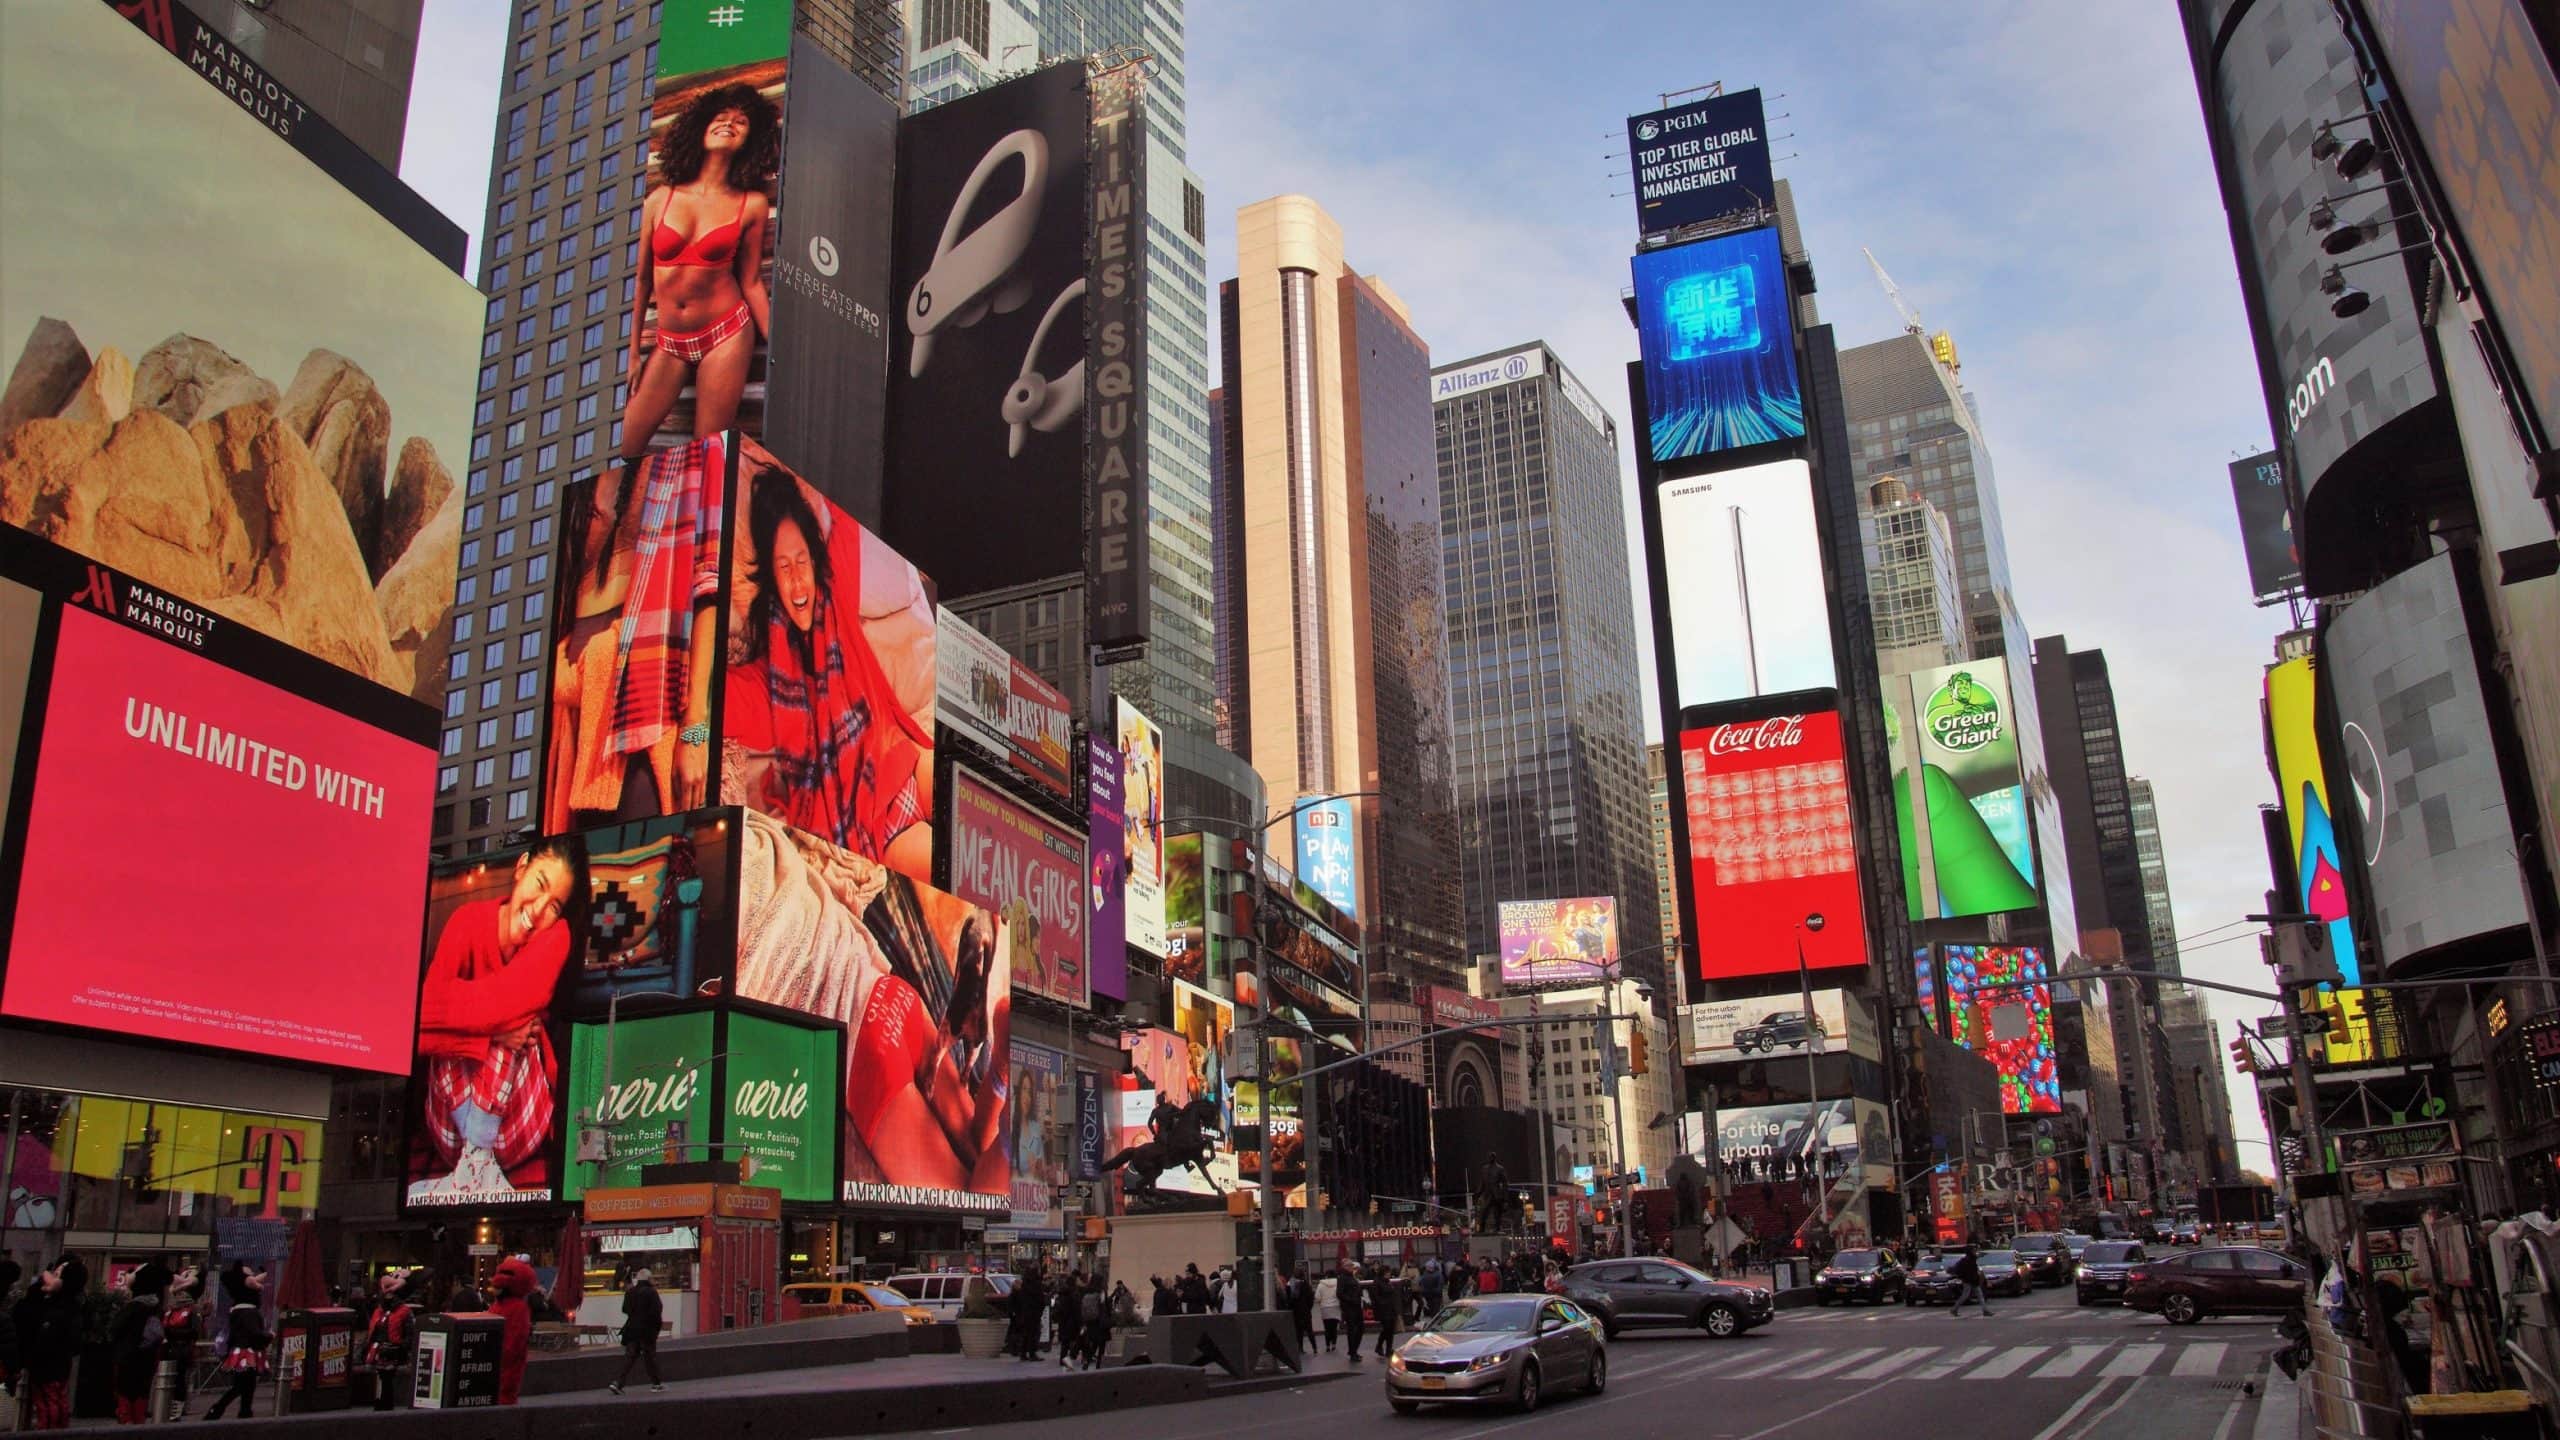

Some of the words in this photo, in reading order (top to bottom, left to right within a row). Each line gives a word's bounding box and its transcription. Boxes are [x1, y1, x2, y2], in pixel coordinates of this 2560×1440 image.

[195, 25, 306, 122] MARRIOTT
[191, 49, 291, 137] MARQUIS
[1664, 110, 1708, 133] PGIM
[1638, 147, 1666, 166] TOP
[1669, 140, 1700, 159] TIER
[1704, 127, 1758, 152] GLOBAL
[1642, 151, 1726, 182] INVESTMENT
[1643, 166, 1737, 201] MANAGEMENT
[1095, 110, 1131, 299] TIMES
[1438, 367, 1500, 395] Allianz
[1095, 320, 1134, 574] SQUARE
[1671, 484, 1713, 497] SAMSUNG
[130, 585, 216, 632] MARRIOTT
[127, 605, 204, 647] MARQUIS
[1009, 693, 1046, 743] JERSEY
[1934, 710, 1998, 733] Green
[1709, 714, 1806, 756] Coca-Cola
[1943, 725, 2001, 749] Giant
[125, 697, 307, 791] UNLIMITED
[315, 763, 385, 819] WITH
[1092, 763, 1103, 781] you
[1104, 767, 1115, 785] feel
[1092, 781, 1111, 801] about
[974, 792, 999, 817] KNOW
[1001, 808, 1016, 828] YOU
[1055, 840, 1070, 857] WITH
[957, 823, 1018, 906] MEAN
[1025, 858, 1080, 937] GIRLS
[1501, 902, 1557, 912] DAZZLING
[1502, 911, 1557, 920] BROADWAY
[1503, 919, 1527, 929] ONE
[1503, 927, 1518, 937] AT
[1519, 927, 1528, 937] A
[1707, 1005, 1719, 1014] the
[1720, 1004, 1742, 1013] urban
[736, 1068, 808, 1120] aerie
[740, 1127, 766, 1140] Power.
[767, 1133, 802, 1146] Positivity.
[1081, 1087, 1100, 1163] FROZEN
[1750, 1121, 1780, 1137] the
[756, 1145, 798, 1161] retouching.
[407, 1193, 456, 1207] AMERICAN
[459, 1192, 488, 1205] EAGLE
[490, 1190, 549, 1203] OUTFITTERS
[848, 1181, 912, 1204] AMERICAN
[916, 1187, 950, 1207] EAGLE
[952, 1190, 1011, 1210] OUTFITTERS
[1937, 1175, 1954, 1213] tkts
[1553, 1200, 1570, 1233] tkts
[1381, 1225, 1434, 1238] HOTDOGS
[319, 1331, 350, 1352] JERSEY
[460, 1362, 493, 1374] AFRAID
